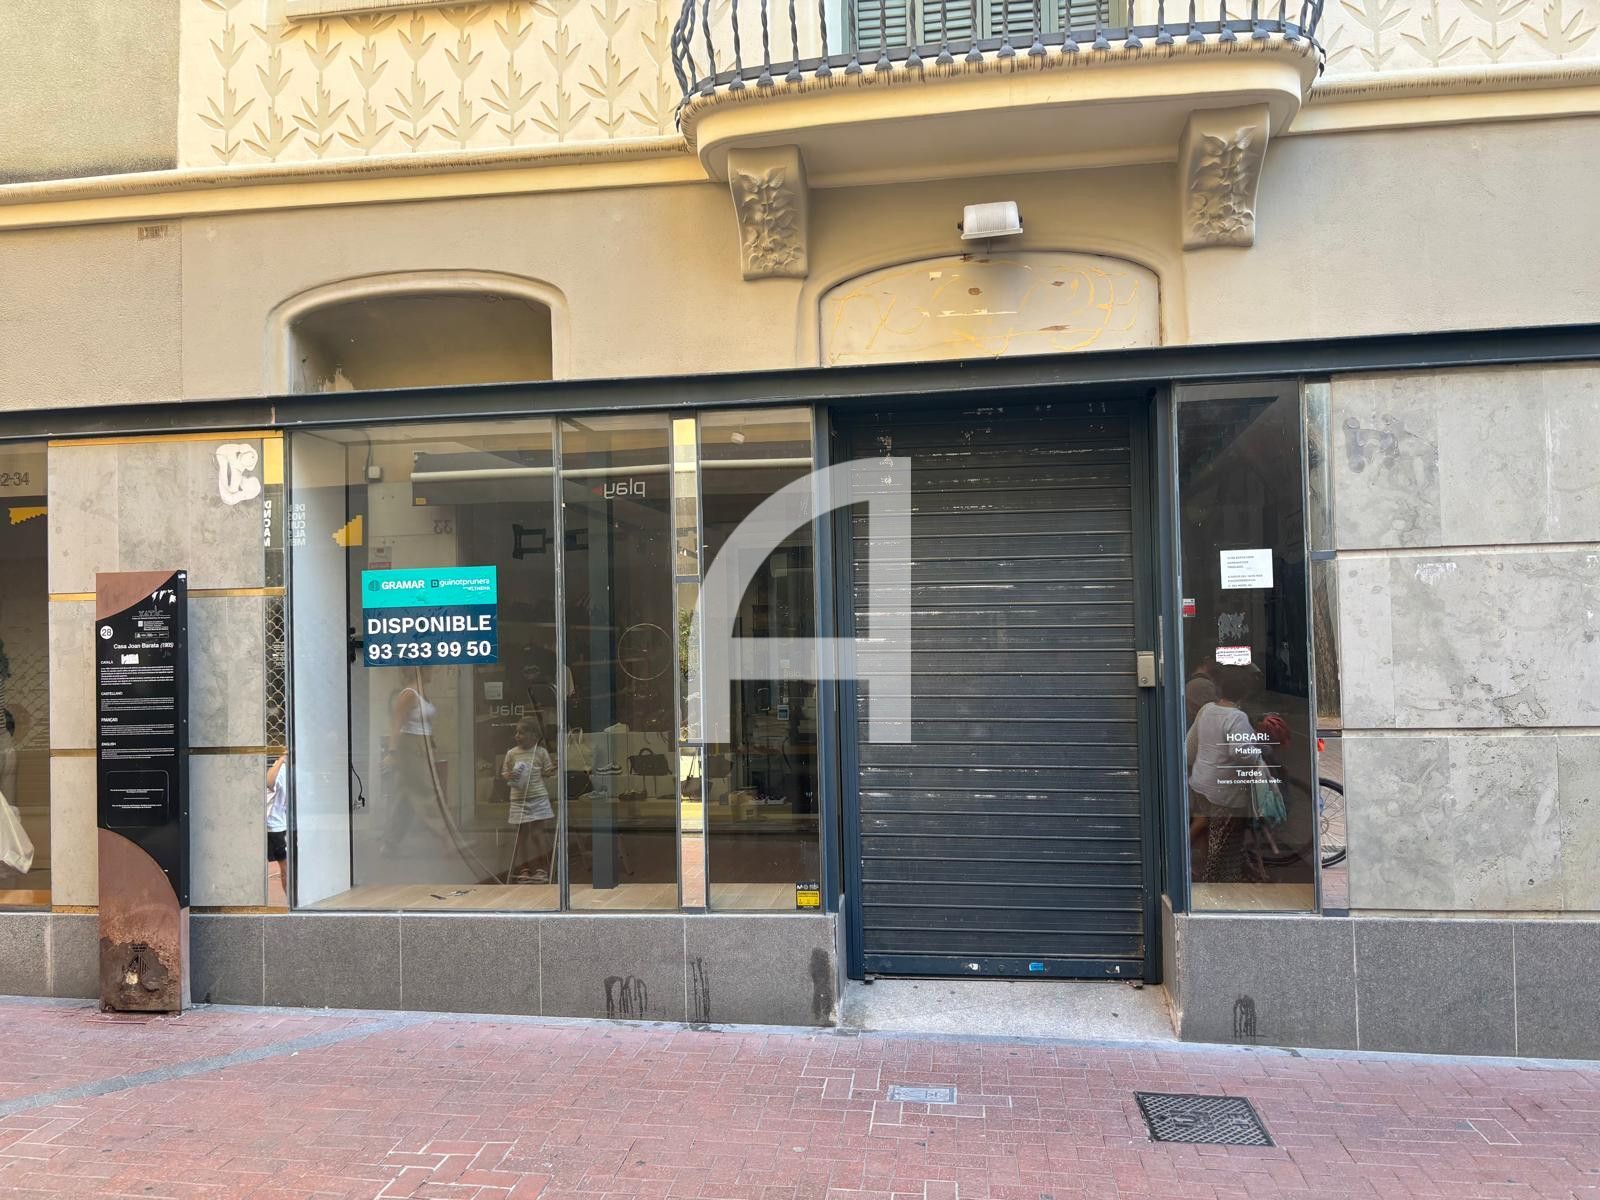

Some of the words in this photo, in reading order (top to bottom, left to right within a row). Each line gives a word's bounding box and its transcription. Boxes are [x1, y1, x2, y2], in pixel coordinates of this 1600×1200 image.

[0, 472, 30, 487] 2-34
[381, 579, 425, 590] GRAMAR
[438, 578, 490, 589] guinotprunera
[367, 614, 492, 635] DISPONIBLE
[101, 628, 112, 637] 28
[368, 644, 392, 660] 93
[397, 643, 432, 659] 733
[437, 641, 462, 657] 99
[466, 640, 492, 657] 50
[1226, 733, 1270, 742] HORARI:
[1236, 769, 1263, 777] Tardes
